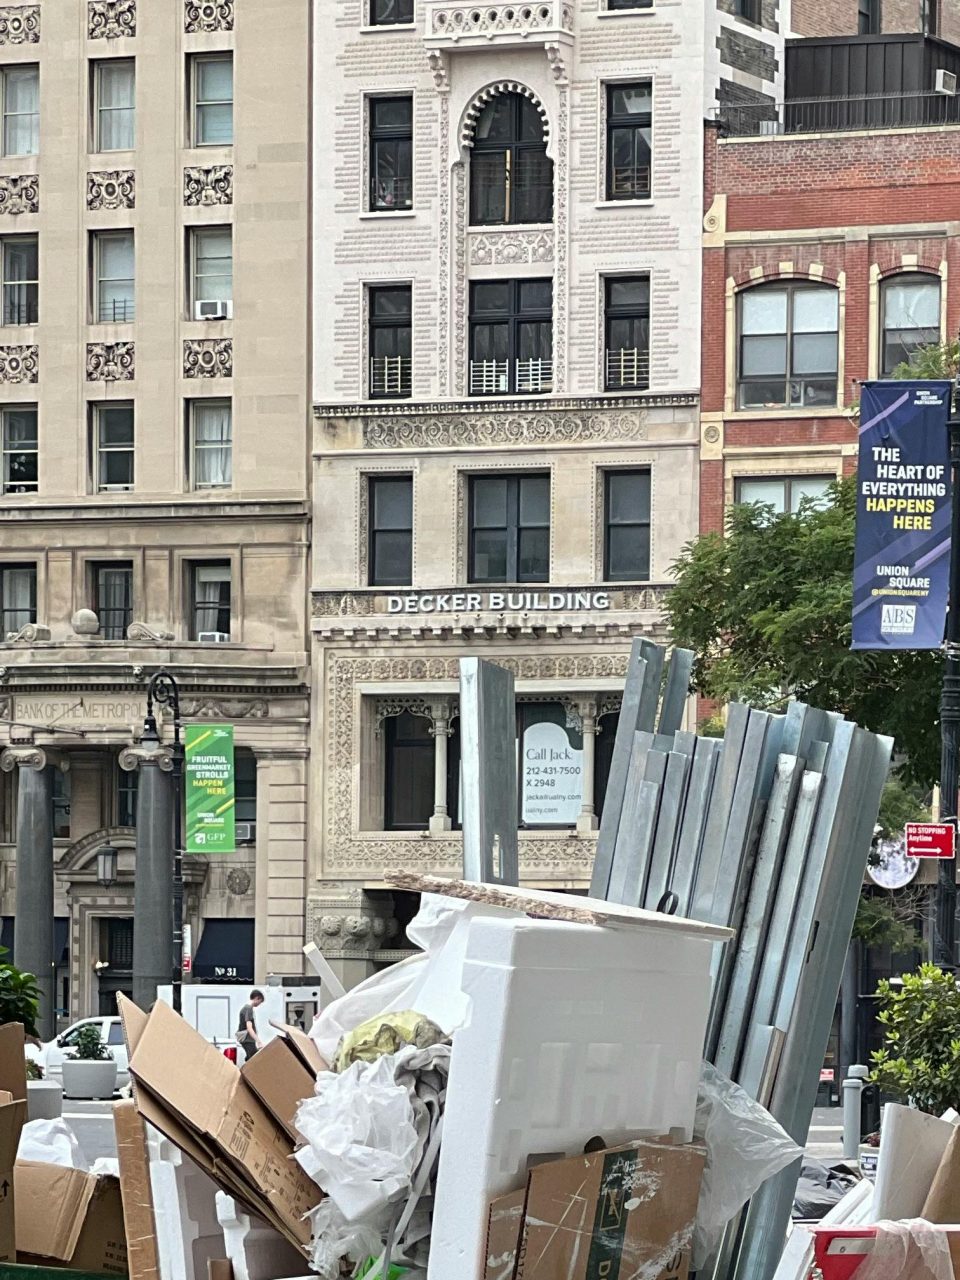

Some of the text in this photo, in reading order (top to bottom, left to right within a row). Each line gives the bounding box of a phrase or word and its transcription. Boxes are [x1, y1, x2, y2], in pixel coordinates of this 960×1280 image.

[872, 447, 900, 462] THE
[877, 464, 944, 480] HEART OF
[862, 481, 946, 497] EVERYTHING
[866, 498, 935, 513] HAPPENS
[893, 515, 932, 530] HERE
[876, 565, 909, 576] UNION
[889, 577, 930, 589] SQUARE
[387, 592, 609, 613] DECKER BUILDING
[883, 608, 914, 625] ABS
[16, 703, 148, 719] BANK OF THE METROPOL
[192, 755, 227, 763] FRUITFUL
[526, 748, 547, 760] Call
[196, 771, 228, 779] STROLLS
[526, 766, 581, 775] 212-431-7500
[192, 779, 223, 787] HAPPEN
[526, 779, 556, 787] X 2948
[207, 787, 227, 795] HERE
[918, 827, 946, 835] STOPPING
[909, 835, 933, 843] Anytime
[226, 967, 237, 977] 31
